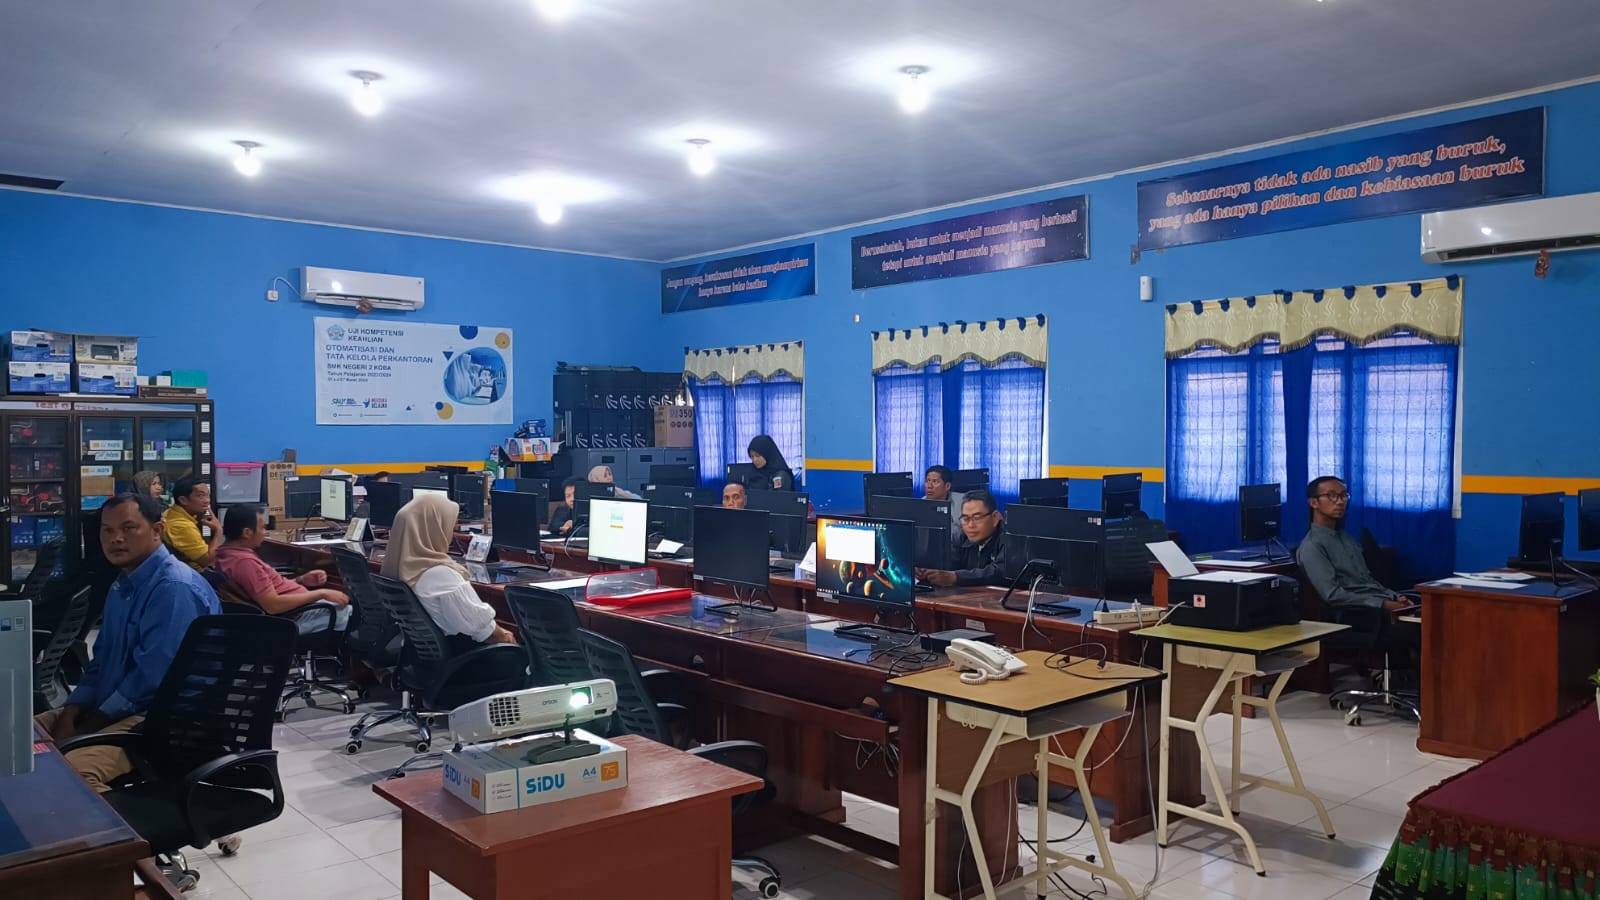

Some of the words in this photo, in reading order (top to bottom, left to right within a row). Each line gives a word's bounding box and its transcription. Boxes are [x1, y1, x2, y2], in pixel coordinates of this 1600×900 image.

[1166, 182, 1250, 207] Sebenarnya
[1254, 170, 1297, 192] tidak
[1301, 166, 1331, 183] ada
[1335, 155, 1383, 178] nasib
[1385, 150, 1433, 172] yang
[1436, 136, 1506, 161] buruk,
[1148, 213, 1182, 232] yang
[1184, 207, 1209, 224] ada
[1212, 202, 1258, 220] hanya
[1260, 192, 1320, 215] pilihan
[1324, 186, 1356, 202] dan
[1360, 170, 1454, 197] kebiasaan
[1458, 156, 1525, 182] buruk
[1019, 218, 1040, 233] yang
[1041, 209, 1078, 227] berhasil
[990, 242, 1010, 257] yang
[360, 328, 404, 337] KOMPETENSI
[326, 344, 377, 353] OTOMATISASI
[378, 355, 433, 364] PERKANTORAN
[526, 773, 565, 795] SiDU
[582, 767, 597, 778] A4
